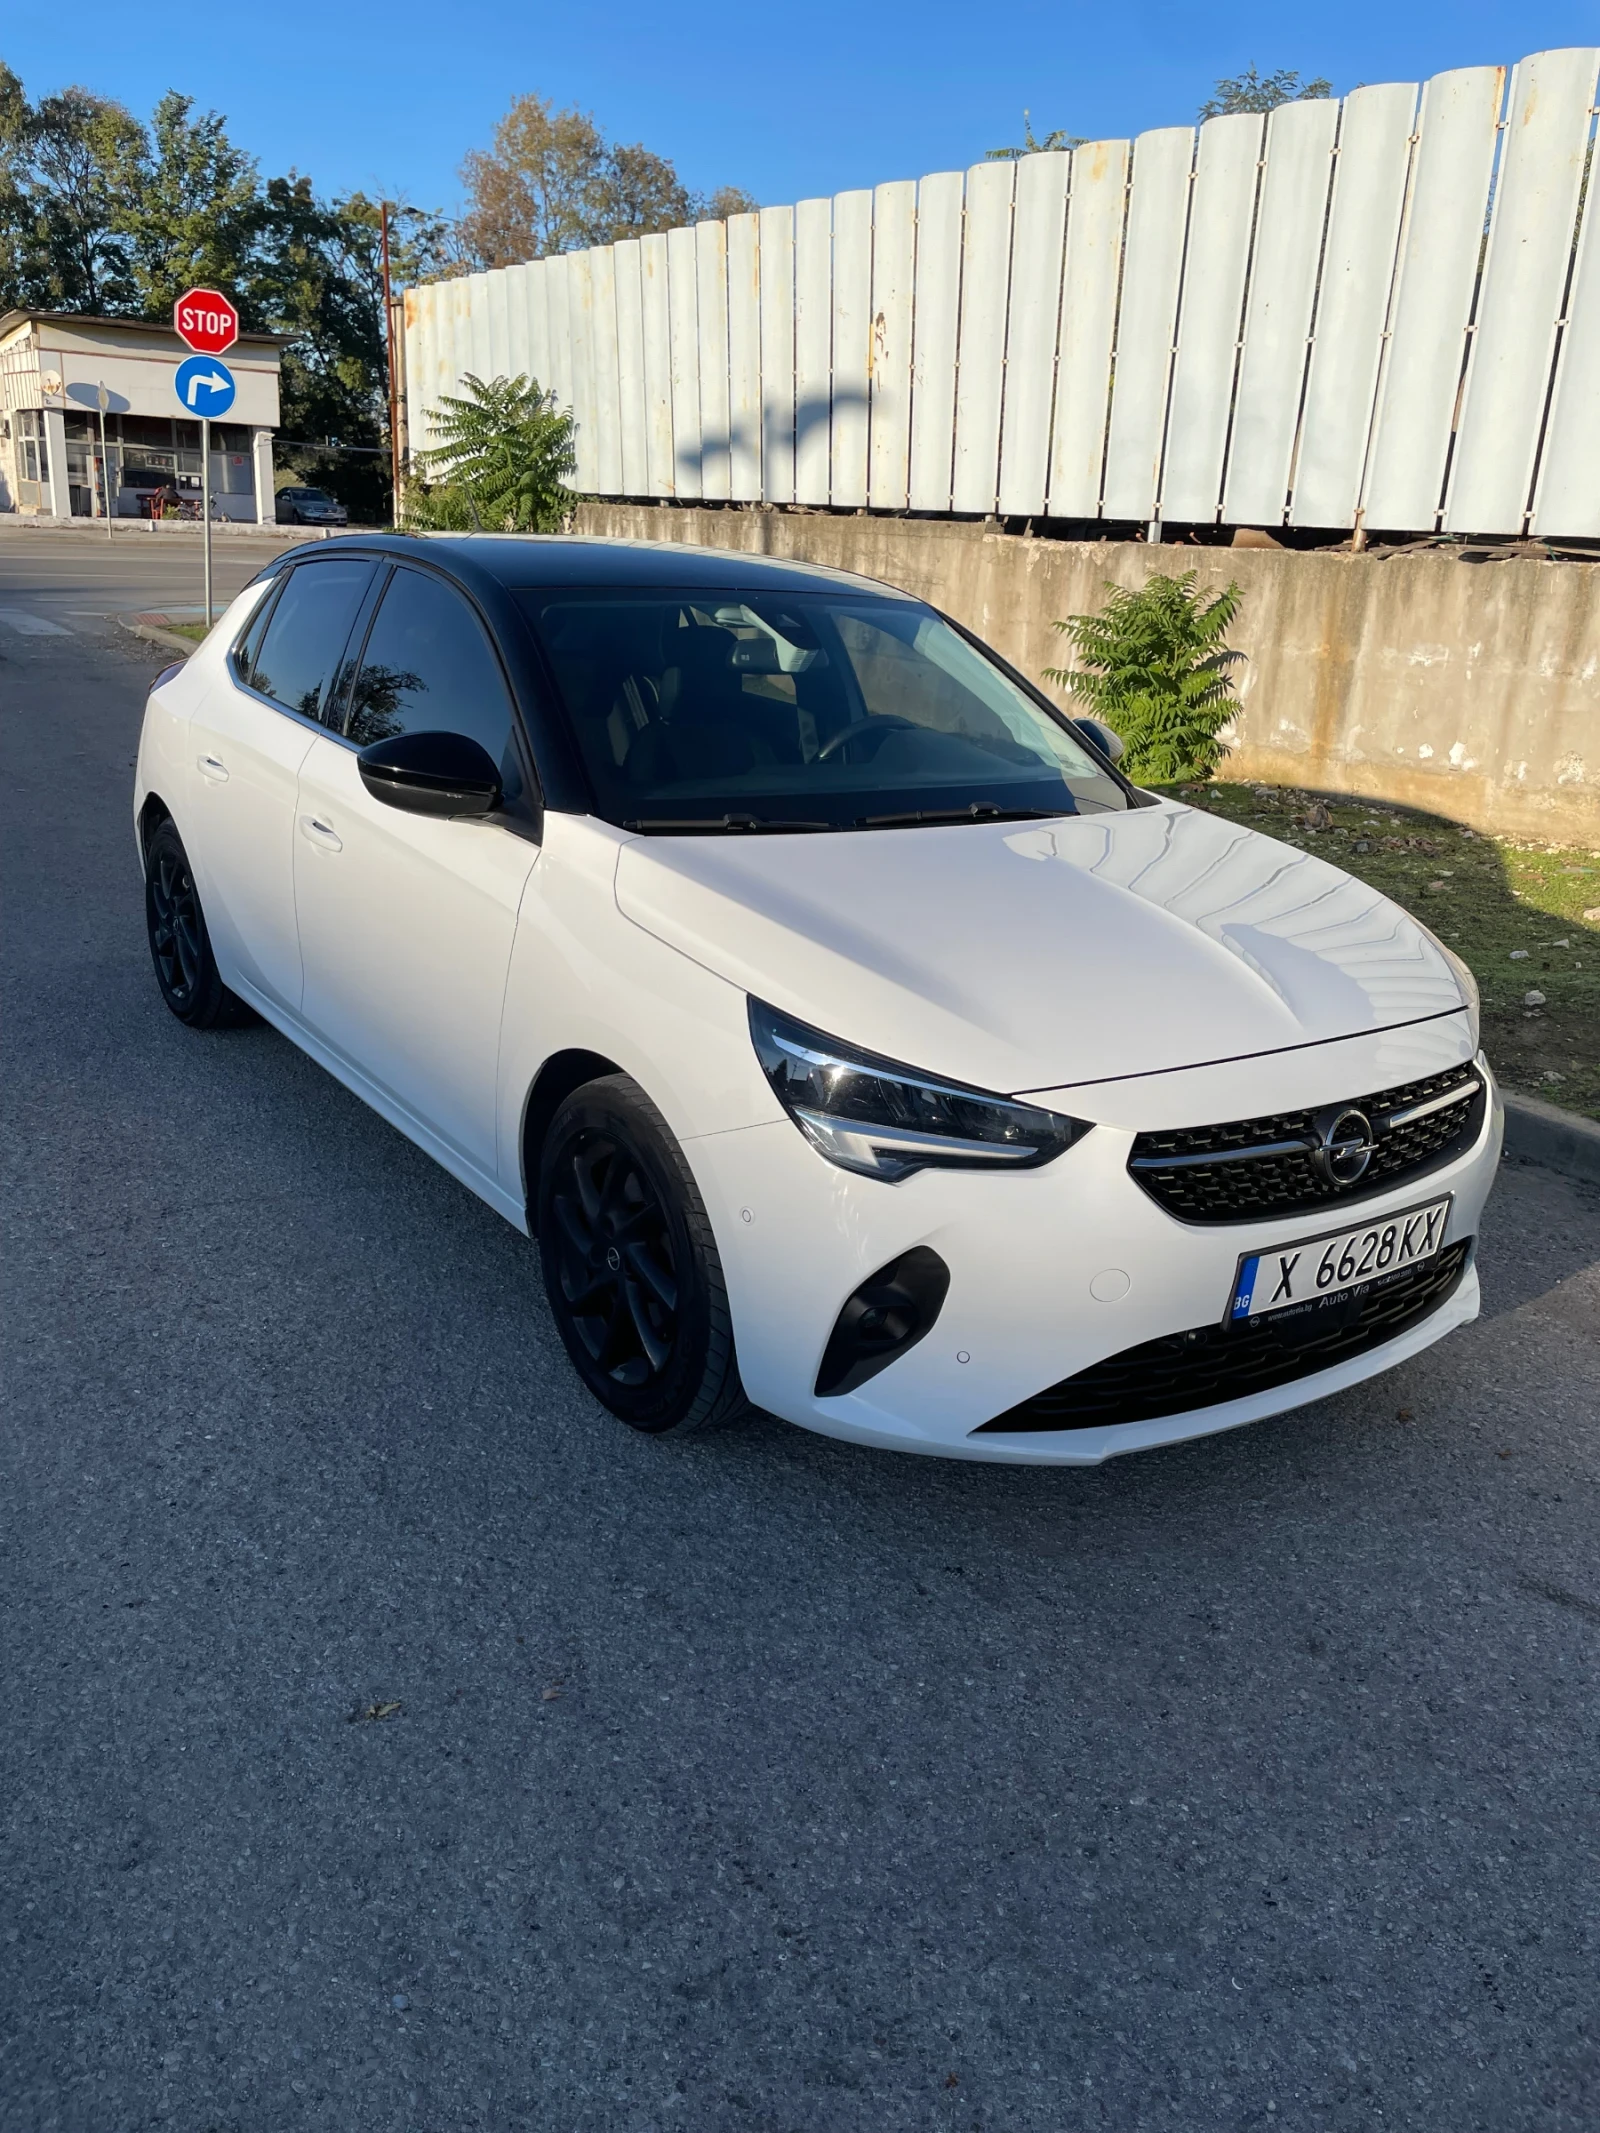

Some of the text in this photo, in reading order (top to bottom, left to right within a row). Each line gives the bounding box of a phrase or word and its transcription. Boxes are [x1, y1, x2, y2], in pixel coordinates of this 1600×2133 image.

[182, 308, 232, 335] STOP
[1269, 1252, 1301, 1303] X
[1233, 1295, 1250, 1311] BG
[1318, 1291, 1348, 1309] Auto
[1352, 1284, 1370, 1298] Via
